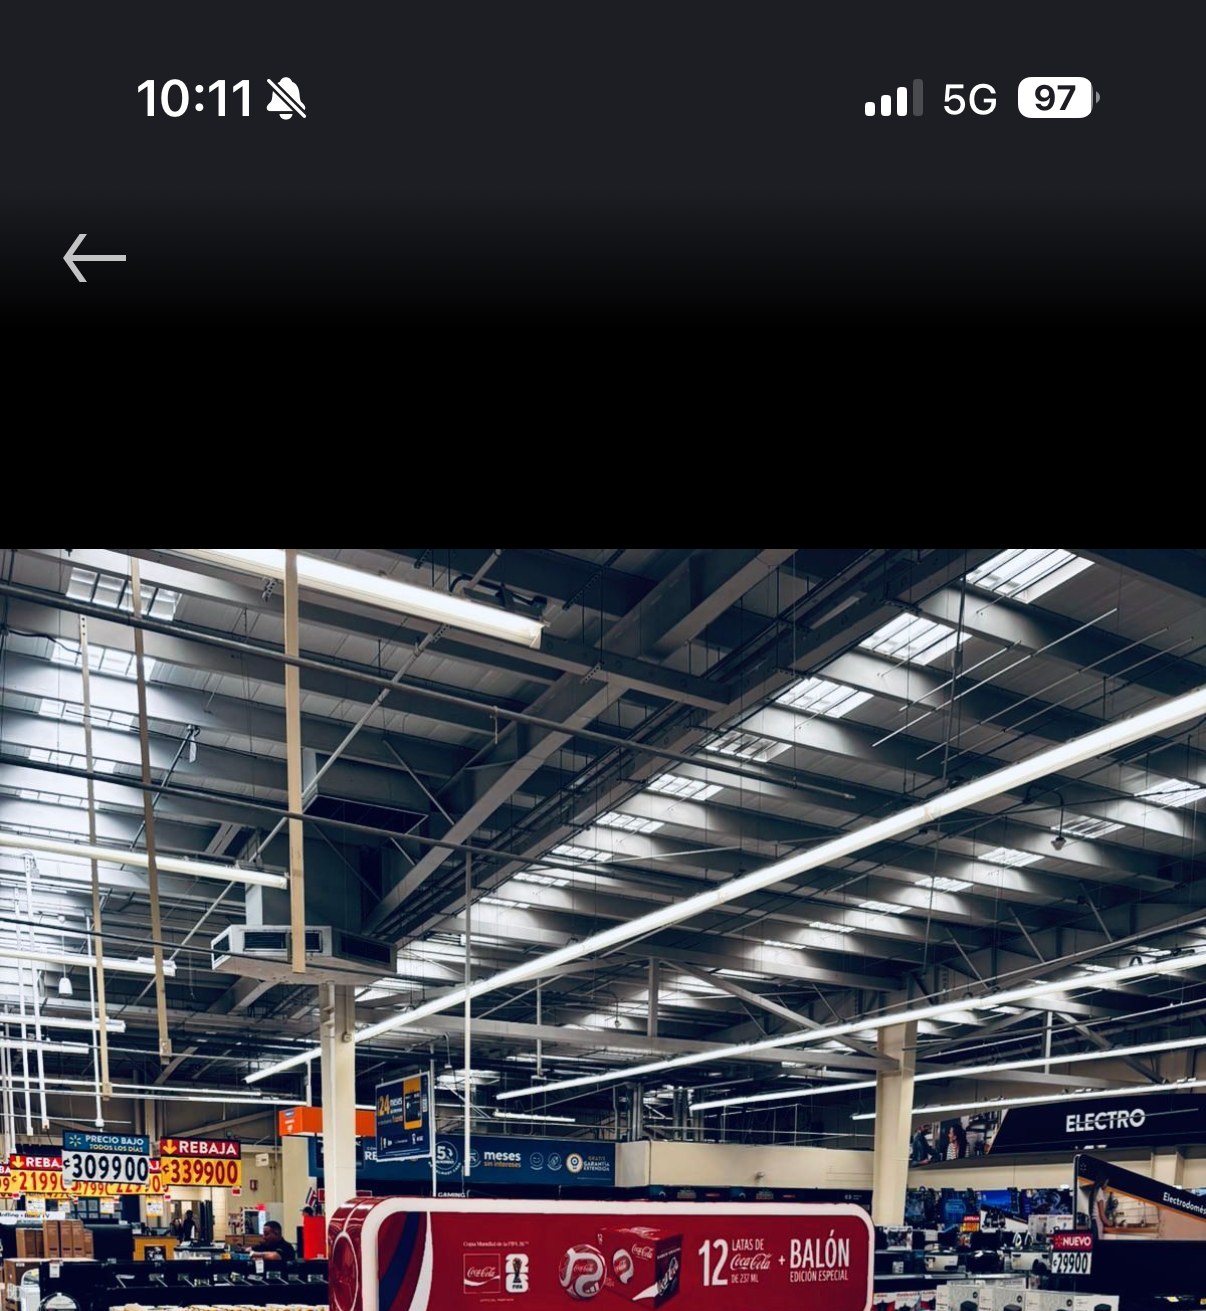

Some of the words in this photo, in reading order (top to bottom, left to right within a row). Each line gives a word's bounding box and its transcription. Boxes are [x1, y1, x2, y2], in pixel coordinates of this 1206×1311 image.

[1066, 1108, 1146, 1133] ELECTRO
[85, 1135, 119, 1145] PRECIO
[121, 1137, 144, 1146] BAJO
[179, 1140, 238, 1155] REBAJA
[26, 1157, 62, 1168] REBA
[484, 1151, 521, 1162] meses
[731, 1239, 753, 1251] LATAS
[755, 1238, 764, 1251] DE
[1063, 1236, 1091, 1247] NUEVO
[790, 1229, 850, 1269] BALÓN
[698, 1239, 728, 1287] 12
[730, 1253, 772, 1271] Coca-Cola
[467, 1266, 496, 1278] Coca-Cola
[790, 1268, 817, 1283] EDICIÓN
[818, 1270, 849, 1282] ESPECIAL
